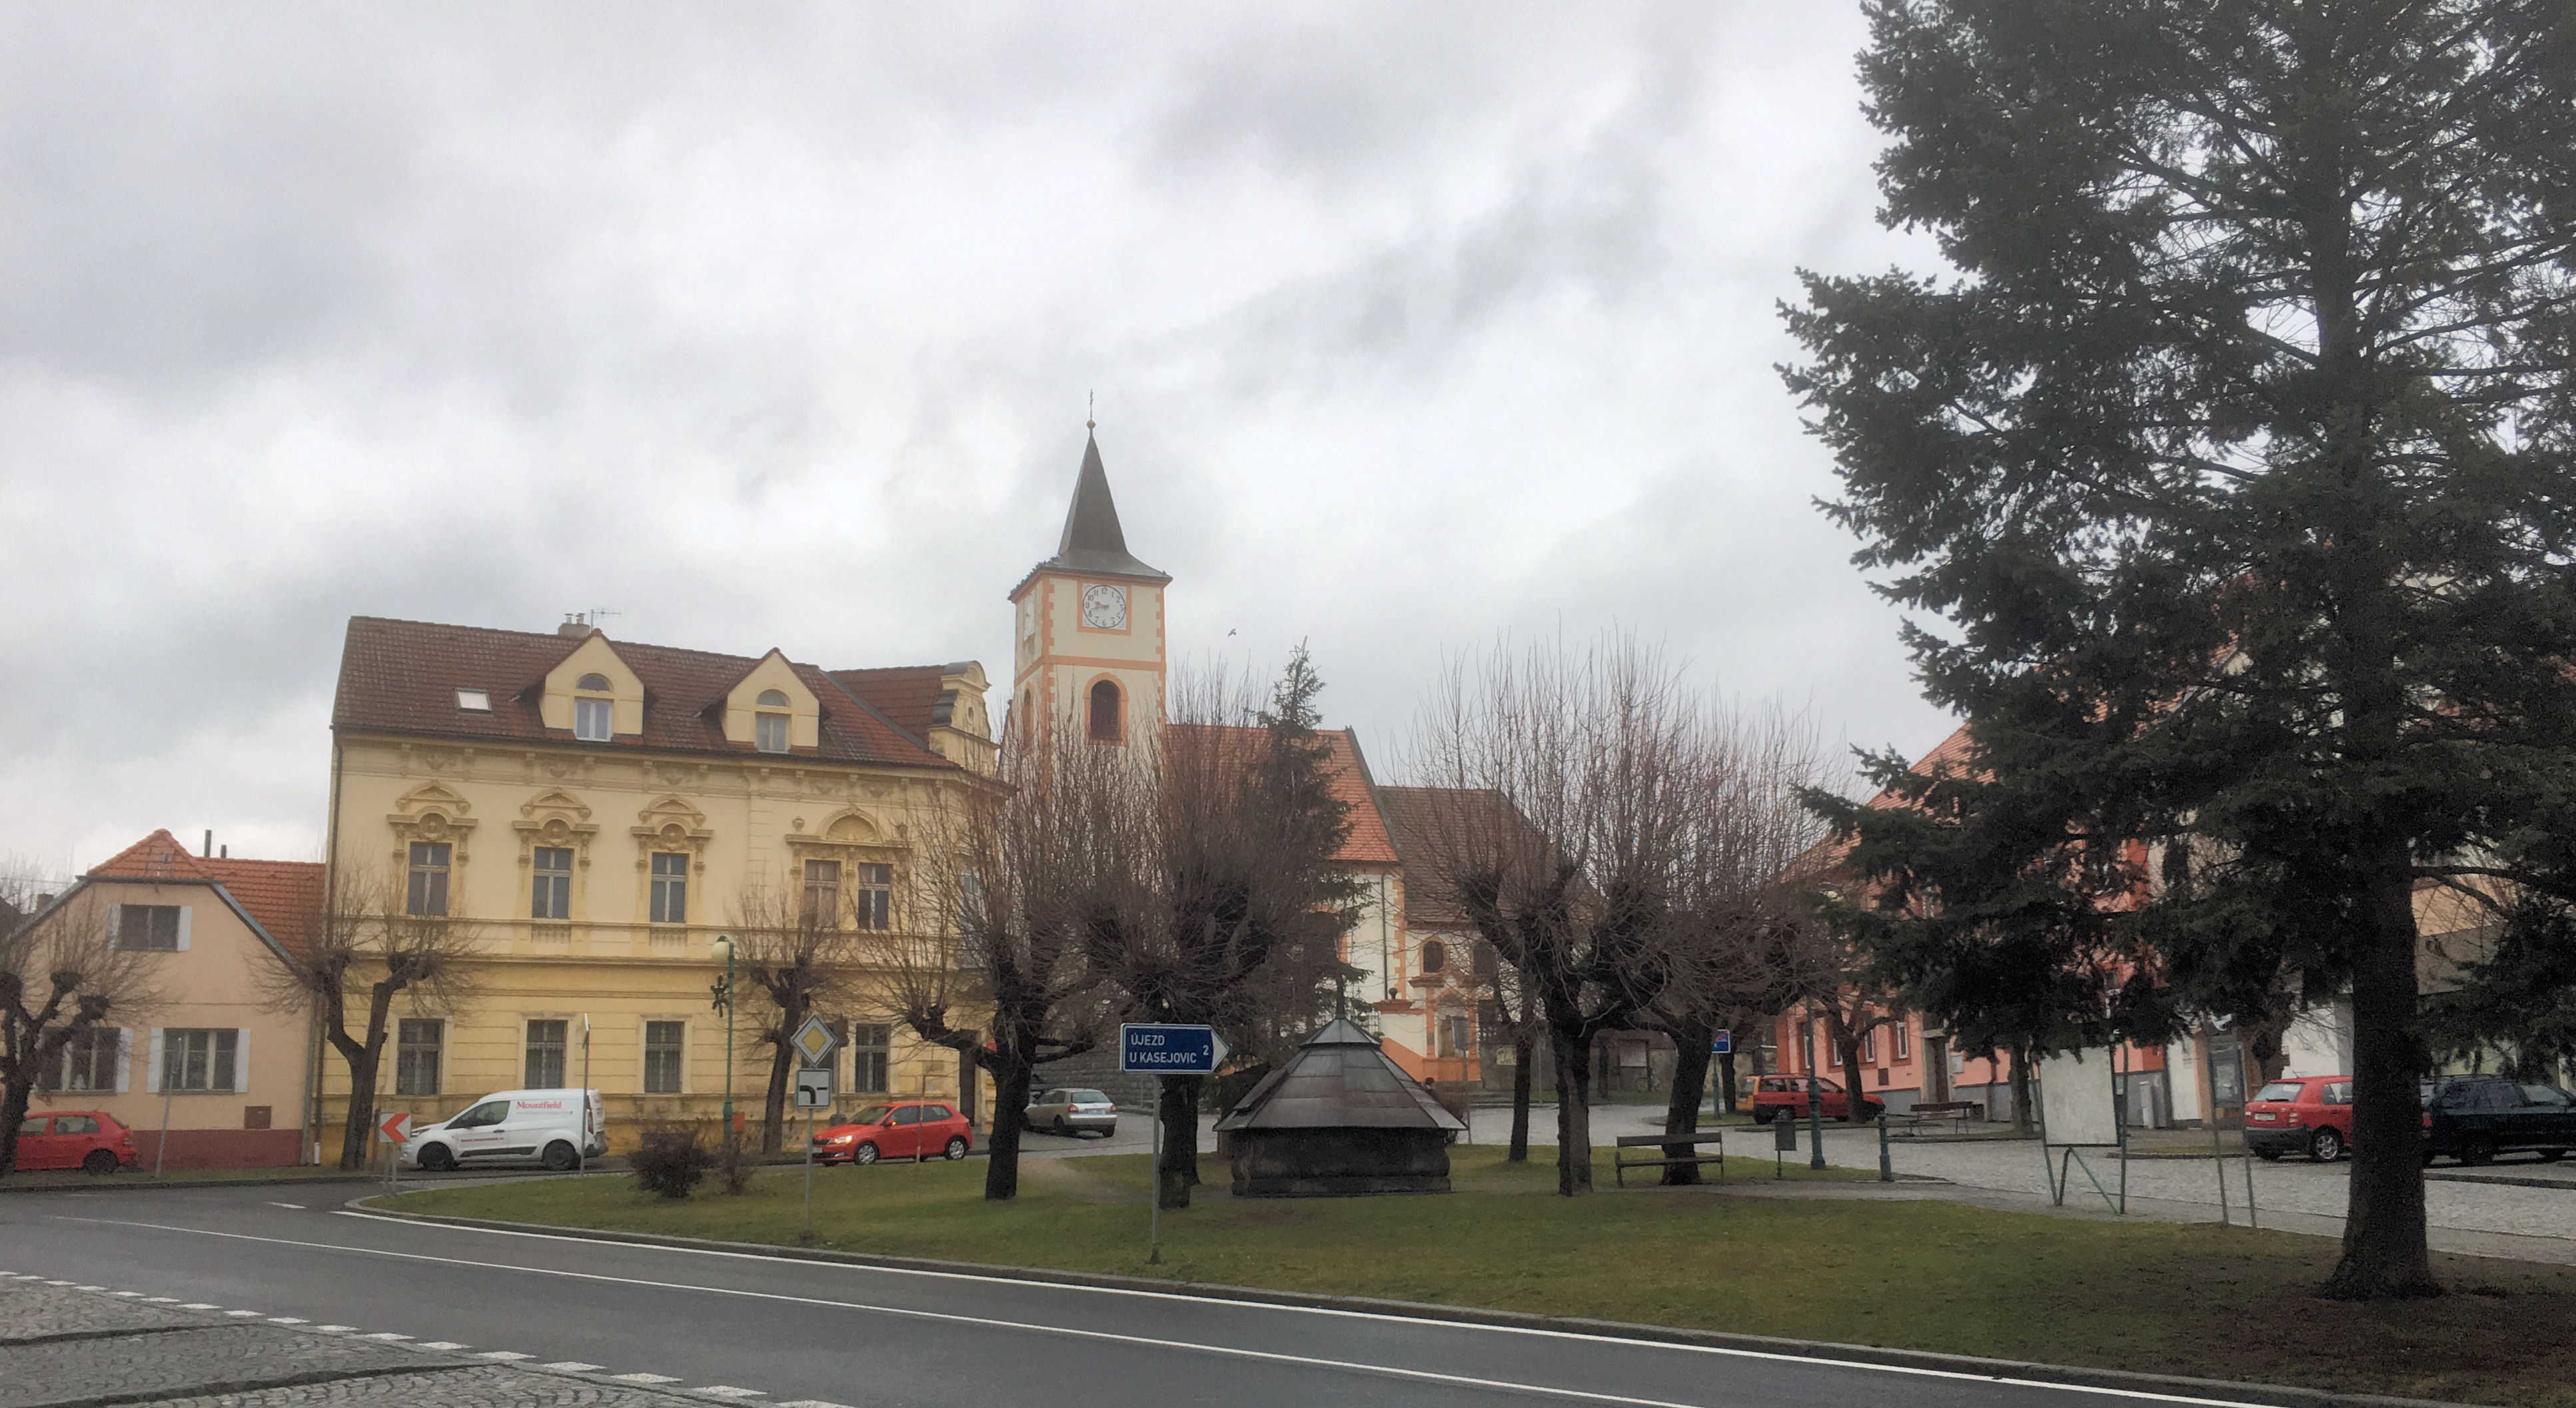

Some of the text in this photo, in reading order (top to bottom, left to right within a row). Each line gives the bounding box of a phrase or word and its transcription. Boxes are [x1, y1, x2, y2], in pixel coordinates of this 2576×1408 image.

[1130, 1032, 1165, 1046] ÚJEZD
[1202, 1044, 1209, 1056] 2
[1129, 1052, 1197, 1064] U KASEJOVIC
